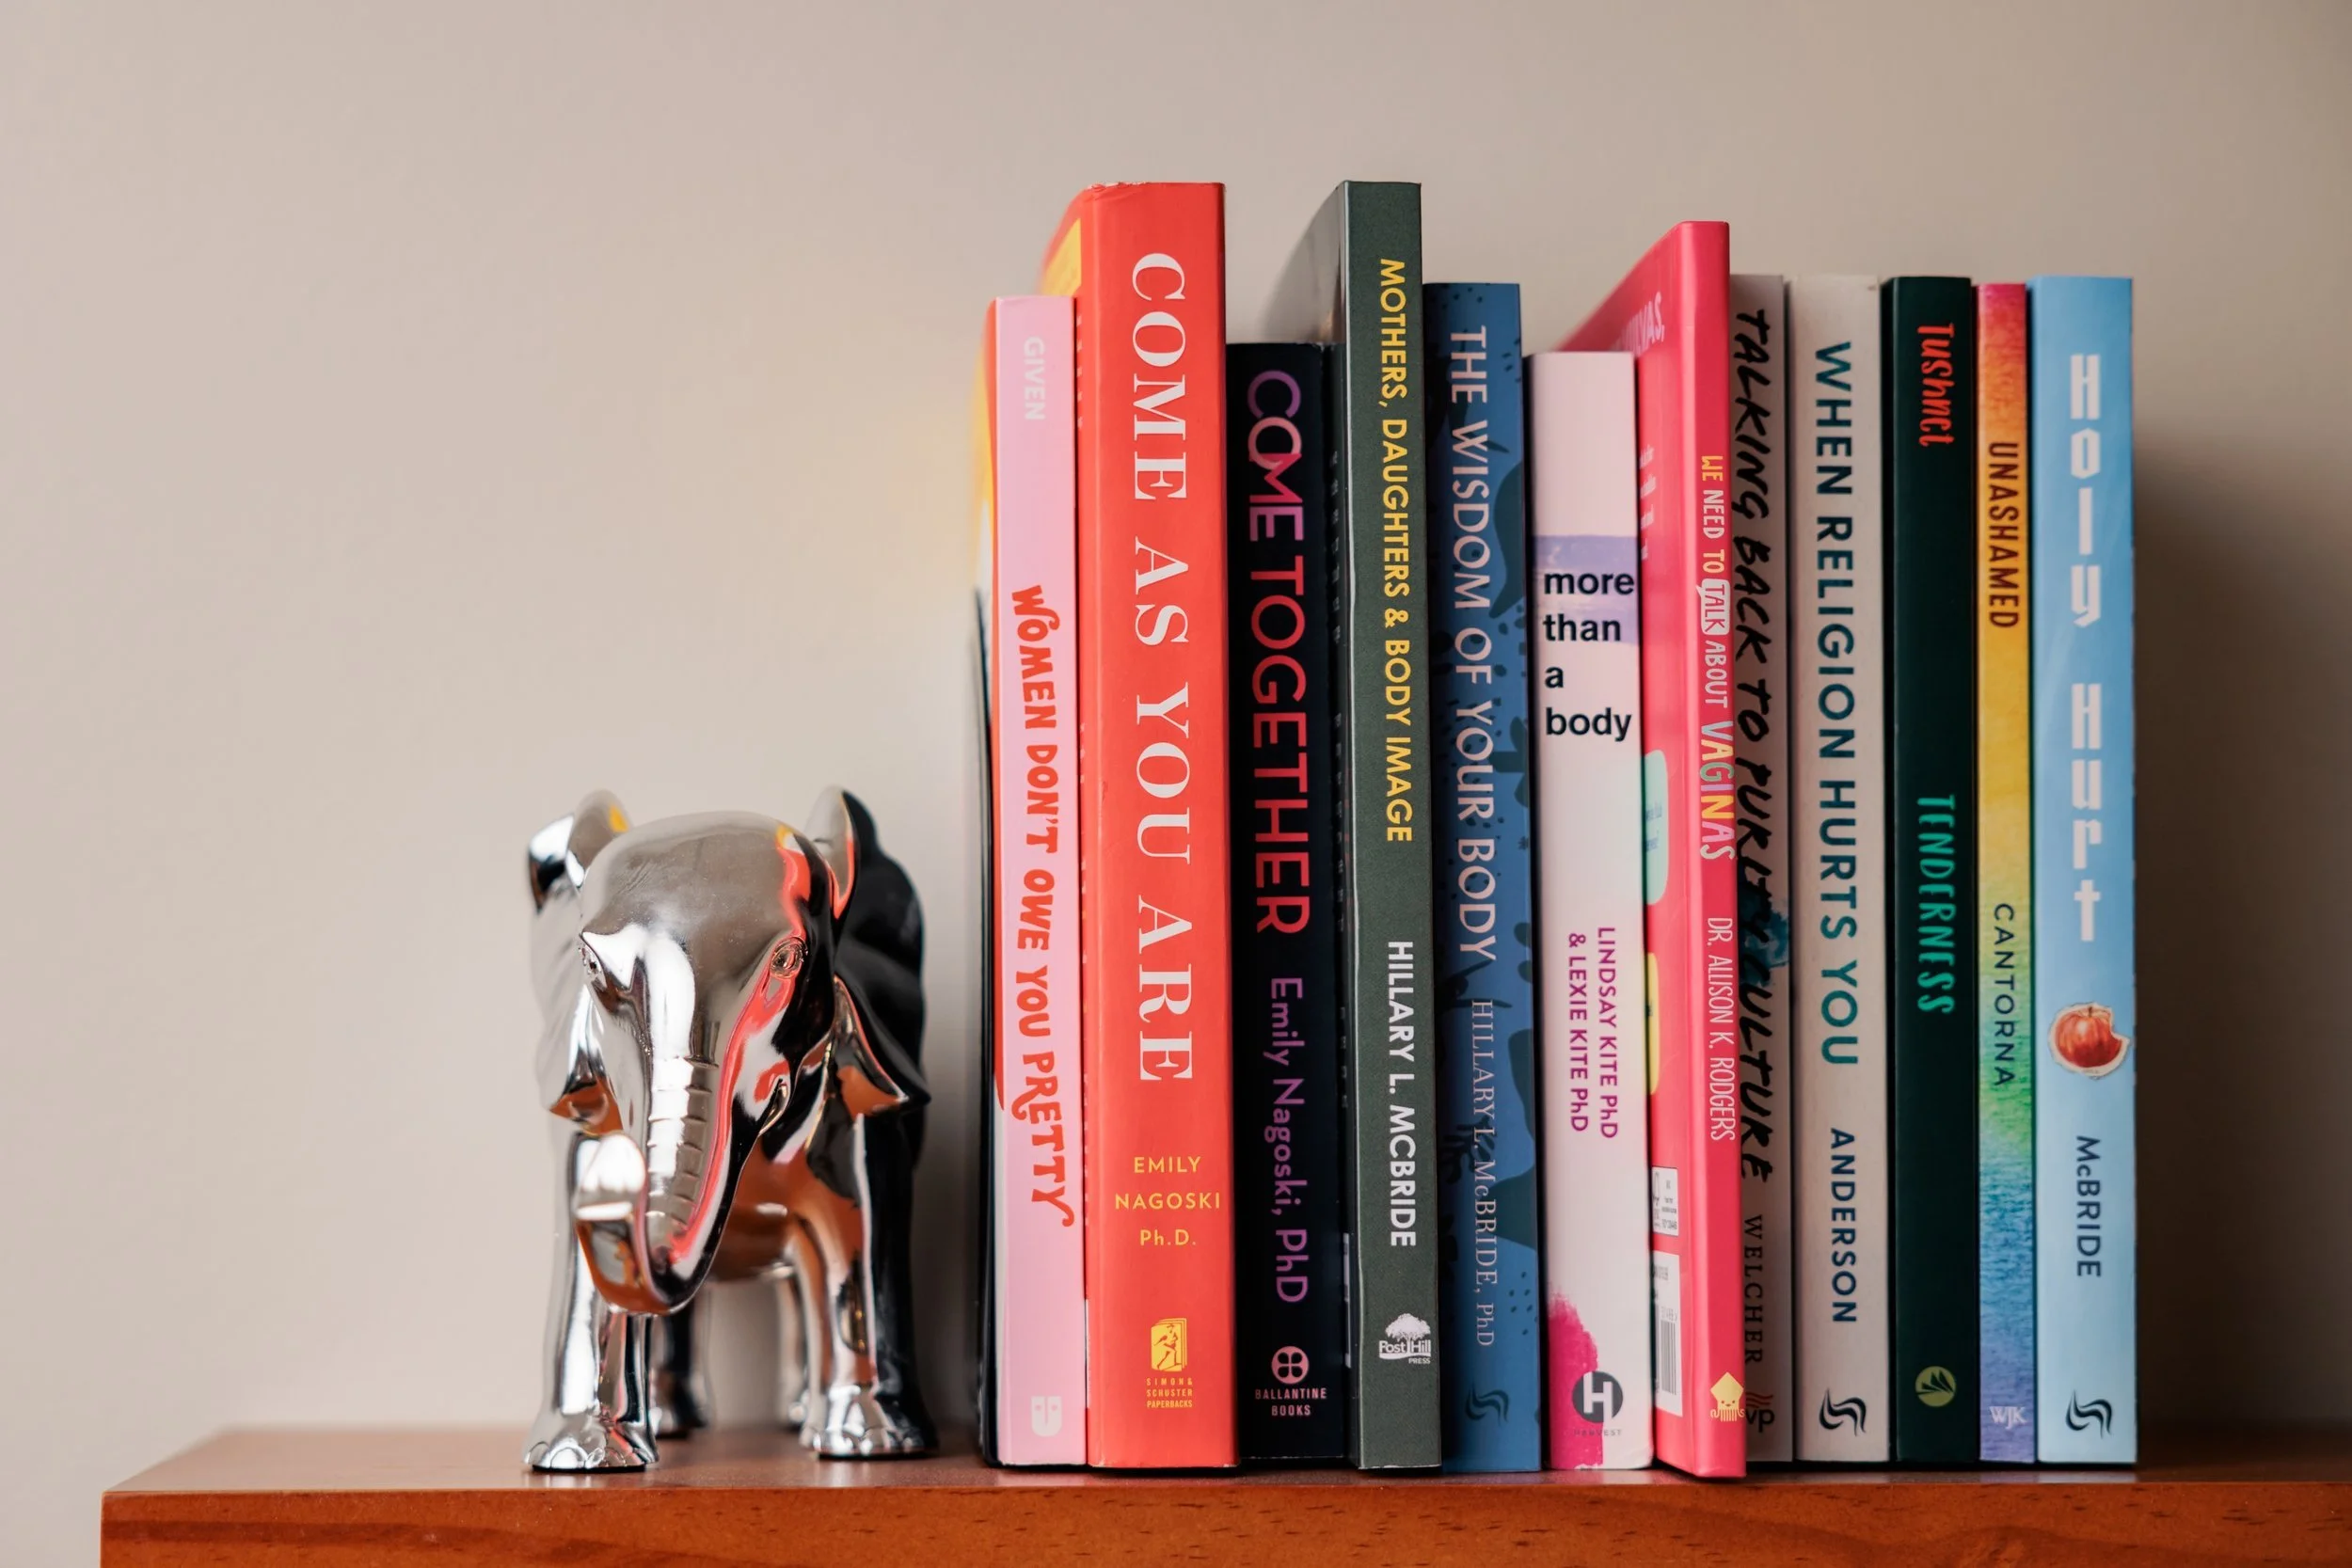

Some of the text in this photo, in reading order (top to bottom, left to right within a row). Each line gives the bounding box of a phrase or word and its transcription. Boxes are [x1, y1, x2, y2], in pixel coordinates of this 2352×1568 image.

[1024, 337, 1045, 420] GIVEN
[1916, 322, 1955, 447] Tushnet
[1378, 259, 1413, 842] MOTHERS, DAUGHTERS & BODY IMAGE
[1544, 572, 1634, 594] more
[1989, 442, 2019, 628] UNASHAMED
[1132, 253, 1193, 1082] COME AS YOU ARE
[1248, 370, 1311, 934] COME TOGETHER
[1450, 325, 1496, 960] THE WISDOM OF YOUR BODY
[1543, 613, 1621, 641] than
[1545, 666, 1564, 688] a
[1699, 455, 1736, 860] WE NEED TO TALK ABOUT VAGINAS
[1816, 341, 1858, 1065] WHEN RELIGION HURTS YOU
[2070, 354, 2102, 942] Holy Hurt
[1546, 707, 1632, 741] body
[1731, 309, 1773, 1183] TALKING BACK TO PURITY CULTURE
[1011, 585, 1074, 1227] WOMEN DON'T OWE YOU PRETTY
[1916, 794, 1957, 1014] TENDERNESS
[1994, 904, 2015, 1086] CANTORNA
[1388, 941, 1417, 1246] HILLARY L. MCBRIDE
[1569, 933, 1588, 1132] & LEXIE KITE PhD
[1597, 927, 1617, 1138] LINDSAY KITE PhD
[1707, 917, 1736, 1141] DR. ALLISON K. RODGERS
[1115, 1193, 1221, 1210] NAGOSKI
[1134, 1156, 1201, 1174] EMILY
[1263, 978, 1309, 1304] Emily Nagoski, PhD
[1471, 999, 1498, 1346] HILLARY L. McBRIDE, PhD
[1831, 1128, 1857, 1323] ANDERSON
[2076, 1135, 2102, 1277] McBRIDE
[1140, 1229, 1197, 1246] Ph.D.
[1744, 1214, 1763, 1363] WELCHER
[1147, 1377, 1193, 1386] SIMON &
[1147, 1388, 1193, 1397] SCHUSTER
[1147, 1400, 1193, 1408] PAPERBACKS
[1255, 1387, 1327, 1400] BALLANTINE
[1271, 1404, 1311, 1416] BOOKS
[1379, 1339, 1431, 1354] Post Hill
[1989, 1405, 2027, 1430] WJK
